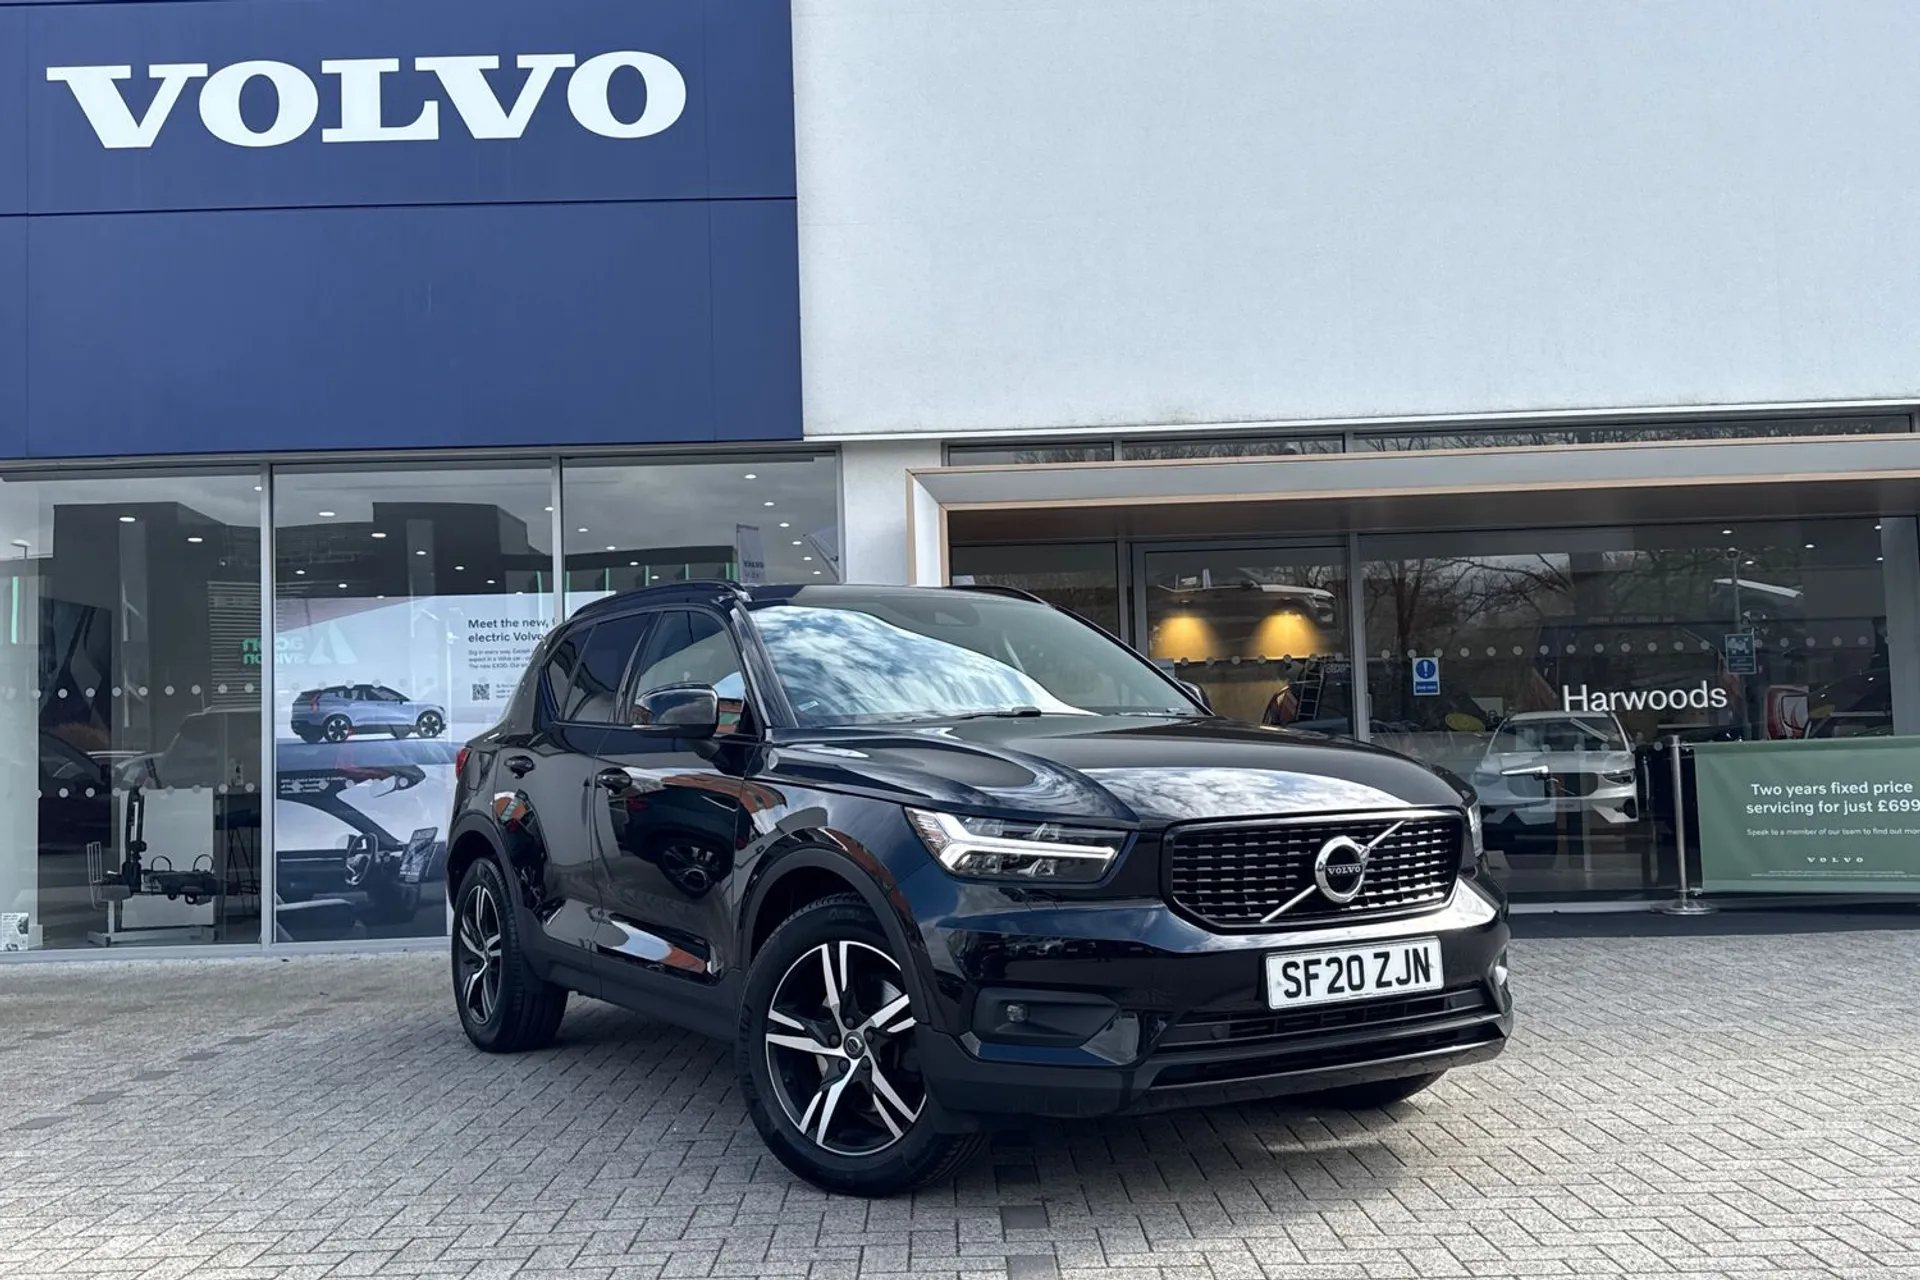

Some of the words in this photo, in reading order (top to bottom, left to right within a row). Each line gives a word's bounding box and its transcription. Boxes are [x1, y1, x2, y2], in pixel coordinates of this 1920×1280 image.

[46, 50, 686, 148] VOLVO
[468, 619, 497, 628] Meet
[501, 618, 519, 628] the
[522, 619, 549, 628] new,
[468, 632, 510, 642] electric
[513, 631, 544, 641] Volvo
[1562, 680, 1728, 712] Harwoods
[1751, 784, 1782, 796] Two
[1785, 785, 1828, 799] years
[1831, 781, 1869, 795] fixed
[1873, 780, 1914, 797] price
[1746, 801, 1814, 817] servicing
[1818, 800, 1841, 814] for
[1843, 799, 1874, 816] just
[1877, 798, 1920, 812] £699
[1746, 828, 1769, 837] Speak
[1786, 828, 1817, 836] member
[1818, 828, 1827, 836] of
[1862, 827, 1872, 835] to
[1872, 827, 1888, 835] find
[1327, 866, 1361, 875] VOLVO
[1281, 955, 1365, 999] SF20
[1373, 947, 1431, 989] ZJN
